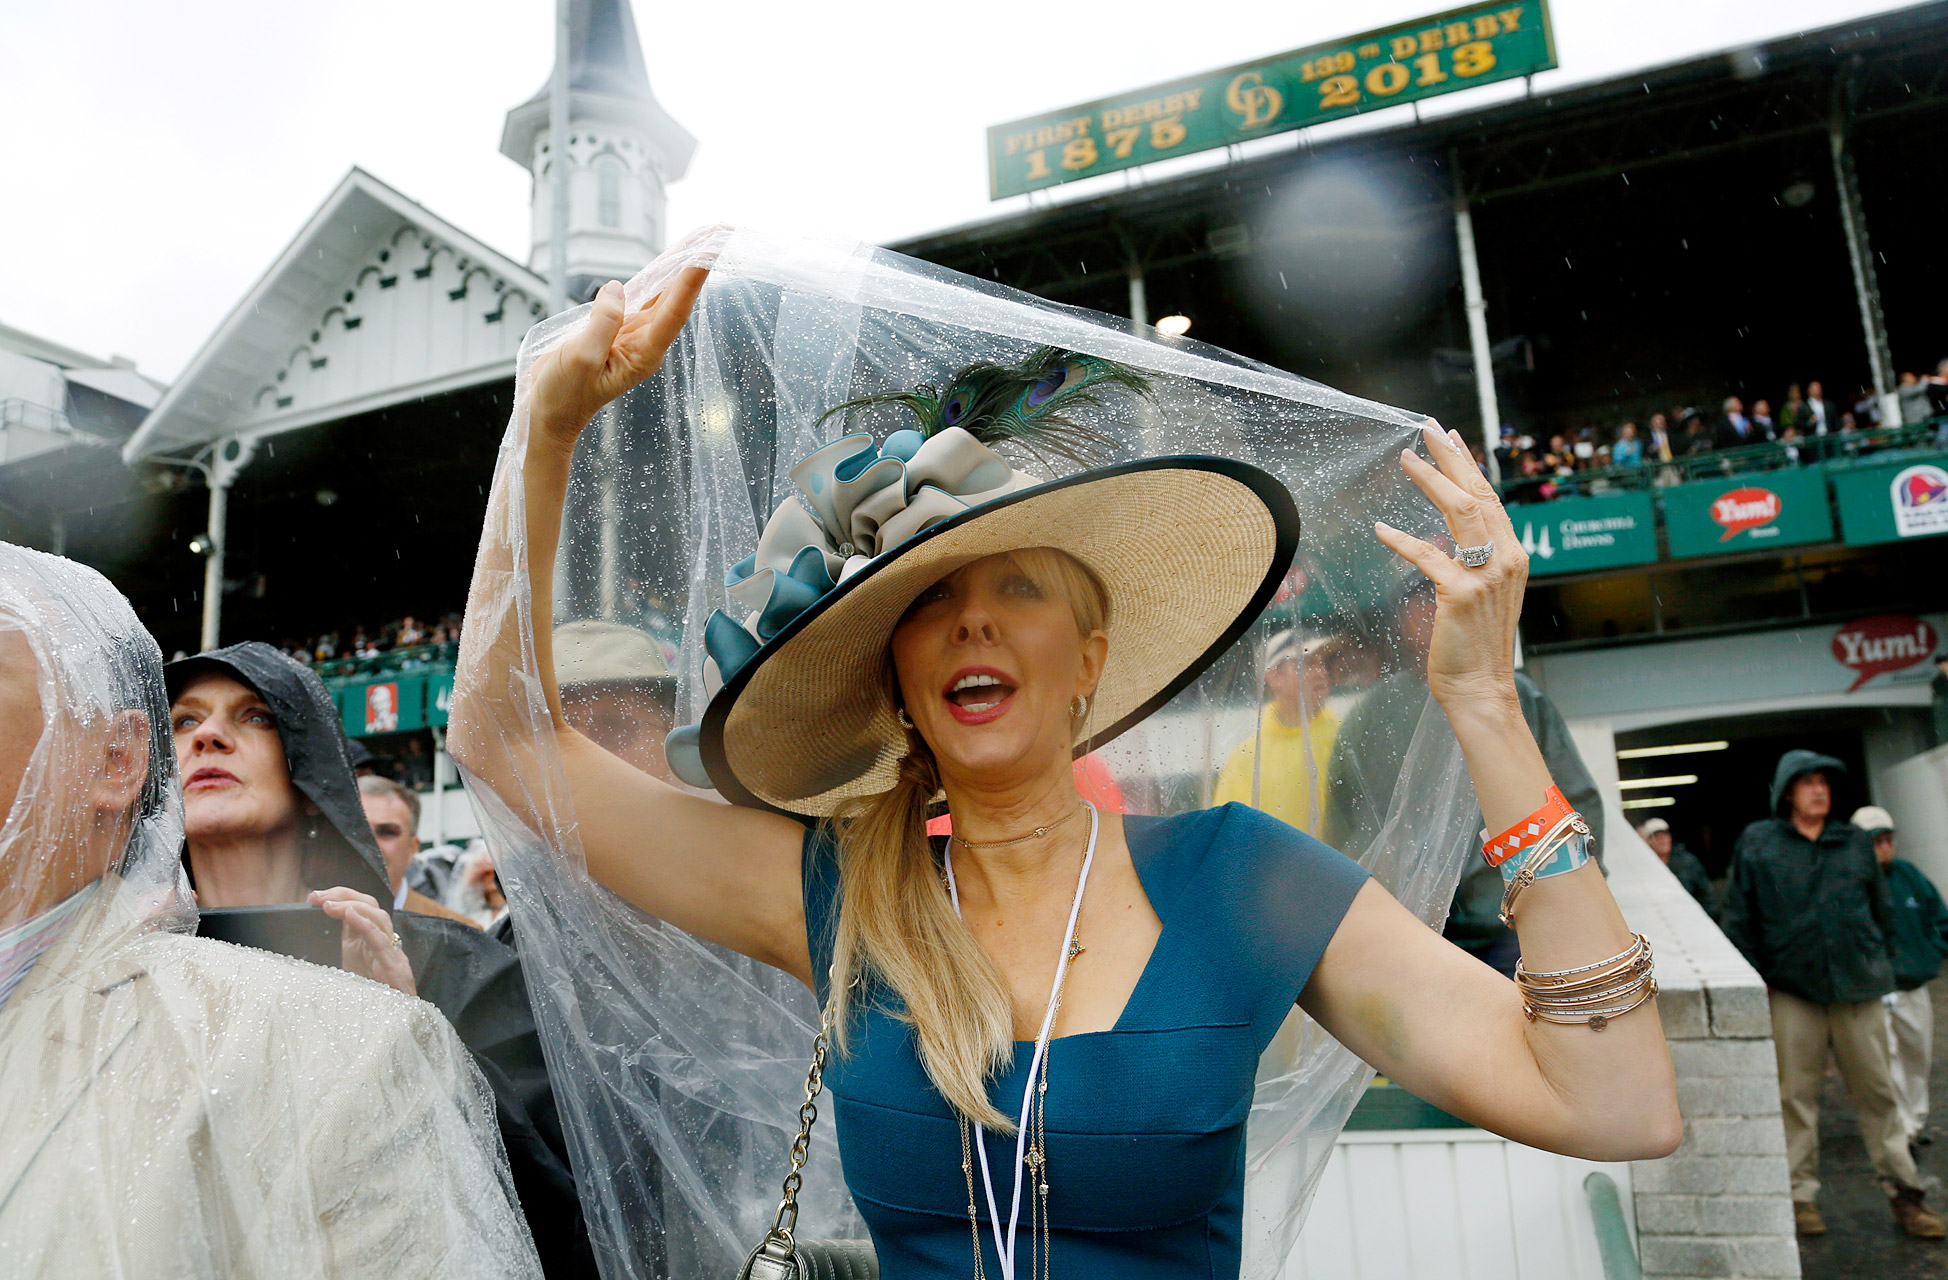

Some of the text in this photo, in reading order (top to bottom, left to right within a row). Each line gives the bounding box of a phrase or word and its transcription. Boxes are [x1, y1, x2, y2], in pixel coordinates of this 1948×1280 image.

[1390, 7, 1524, 60] DERBY
[1319, 41, 1497, 109] 2013
[1005, 87, 1203, 156] FIRST DERBY
[1026, 116, 1187, 180] 1875
[1713, 493, 1776, 522] Yum!
[1838, 624, 1928, 664] Yum!
